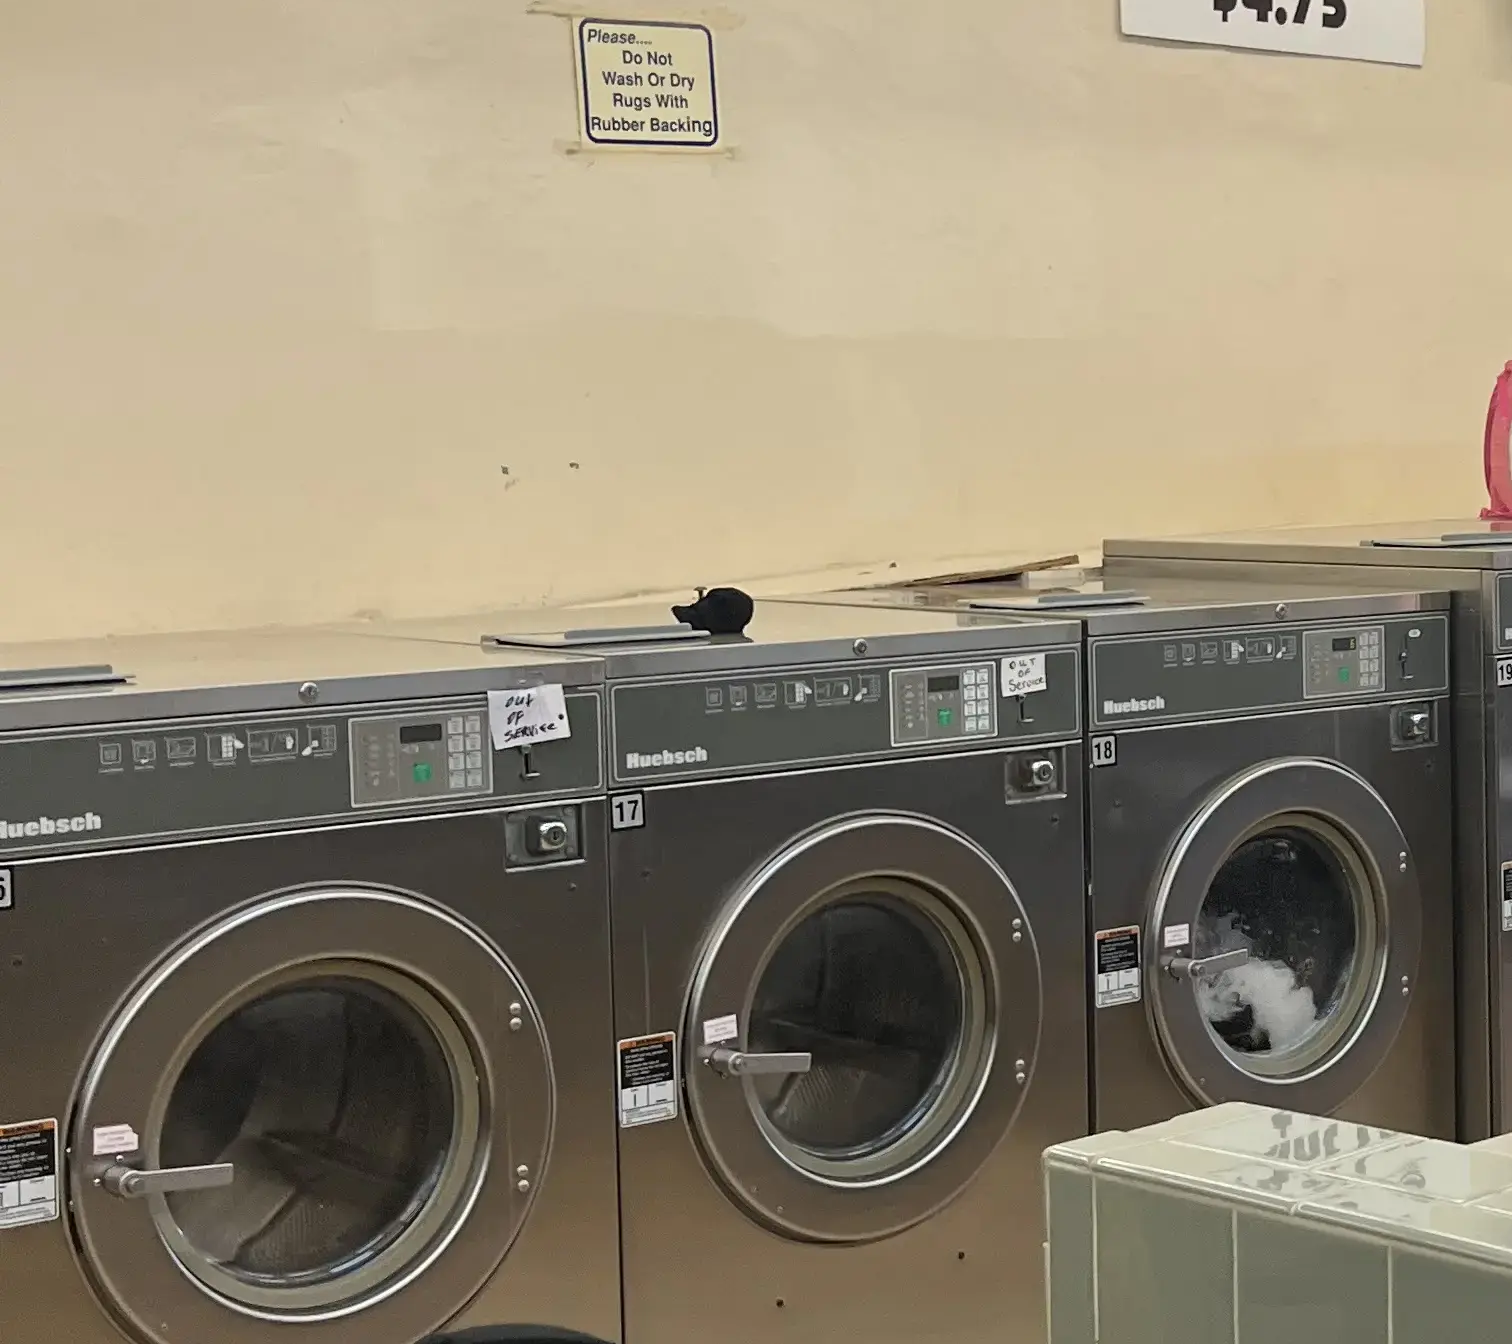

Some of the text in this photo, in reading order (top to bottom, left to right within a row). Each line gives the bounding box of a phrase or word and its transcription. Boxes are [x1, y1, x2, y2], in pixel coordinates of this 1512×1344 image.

[622, 50, 673, 66] Do Not
[602, 71, 695, 91] Wash Or Dry
[613, 93, 689, 111] Rugs With
[591, 116, 713, 137] Rubber Backing
[1499, 664, 1512, 681] 19
[1103, 696, 1165, 714] Huebsch
[626, 746, 708, 769] Huebsch
[1094, 741, 1113, 760] 18
[615, 800, 639, 822] 17
